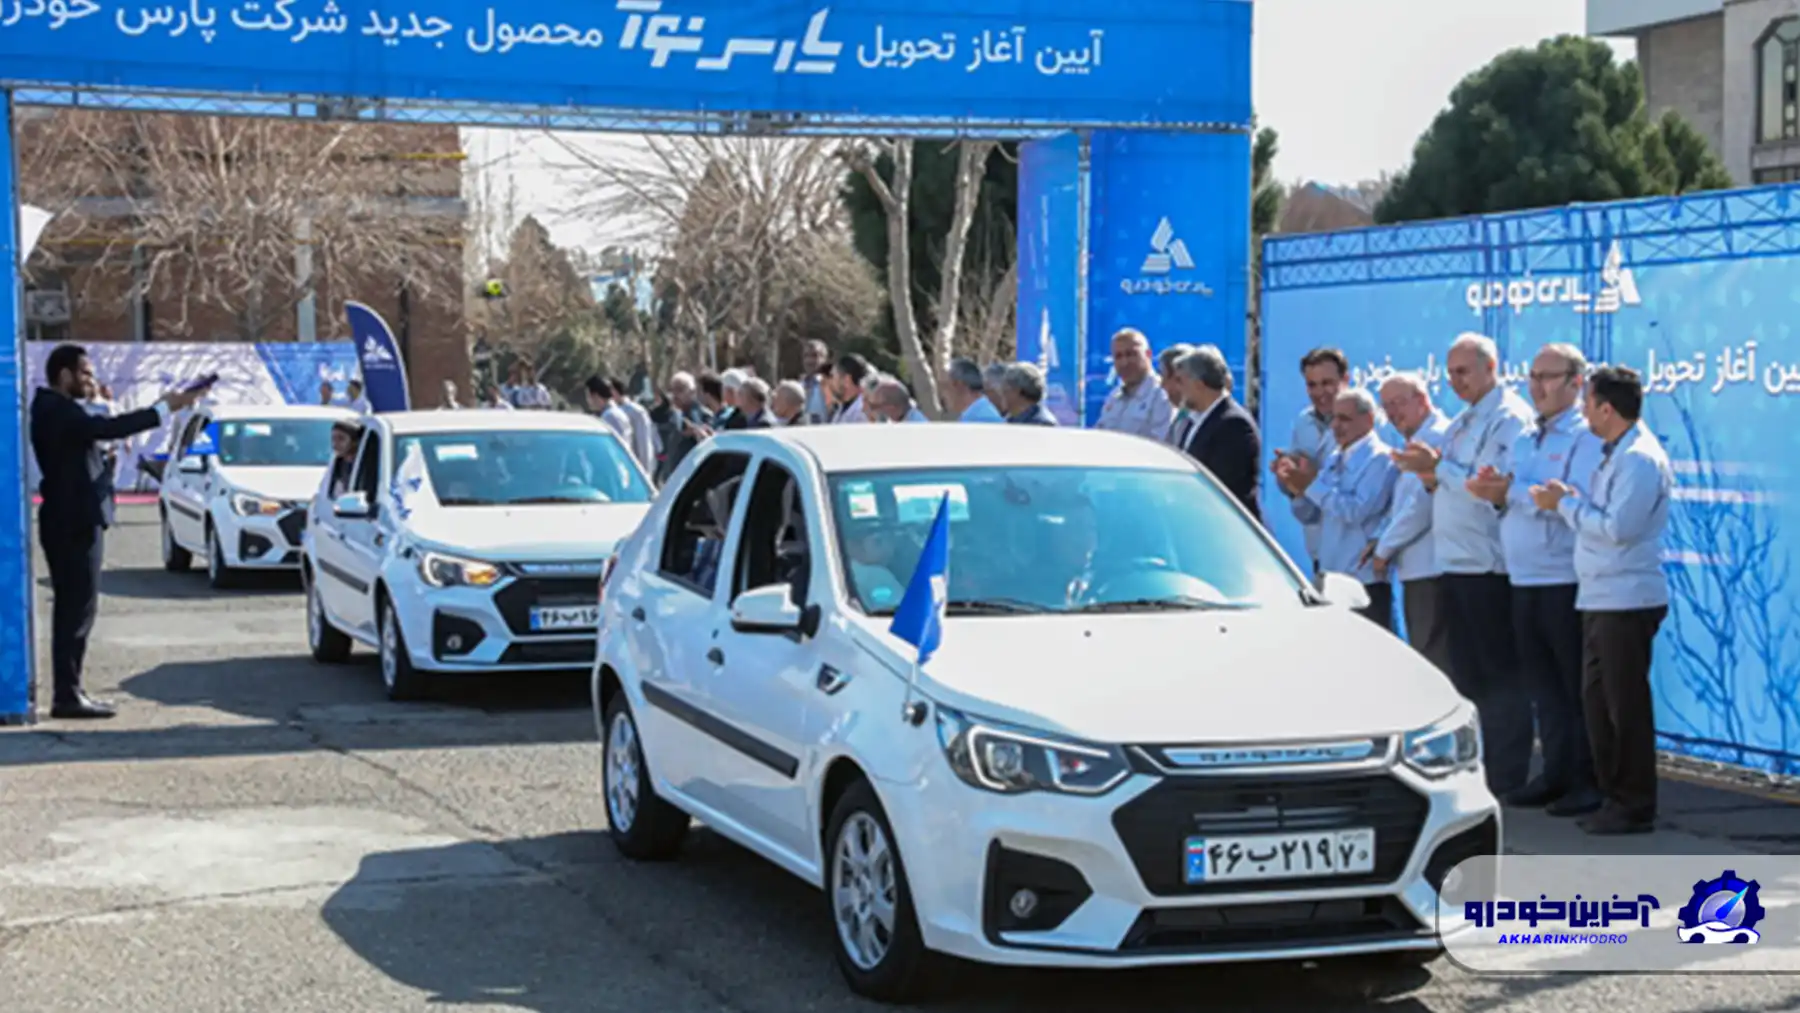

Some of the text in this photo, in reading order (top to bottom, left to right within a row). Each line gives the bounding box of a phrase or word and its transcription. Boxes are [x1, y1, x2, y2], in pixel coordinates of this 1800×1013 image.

[0, 0, 100, 29] خودر
[116, 0, 216, 43] پارس
[231, 0, 348, 43] شرکت
[361, 10, 452, 49] جدید
[466, 8, 603, 51] محصول
[696, 6, 843, 73] پارس
[857, 25, 956, 69] تحویل
[966, 26, 1025, 72] آغاز
[1036, 29, 1104, 74] آیین
[1642, 348, 1706, 394] تحویل
[1711, 340, 1758, 393] آغاز
